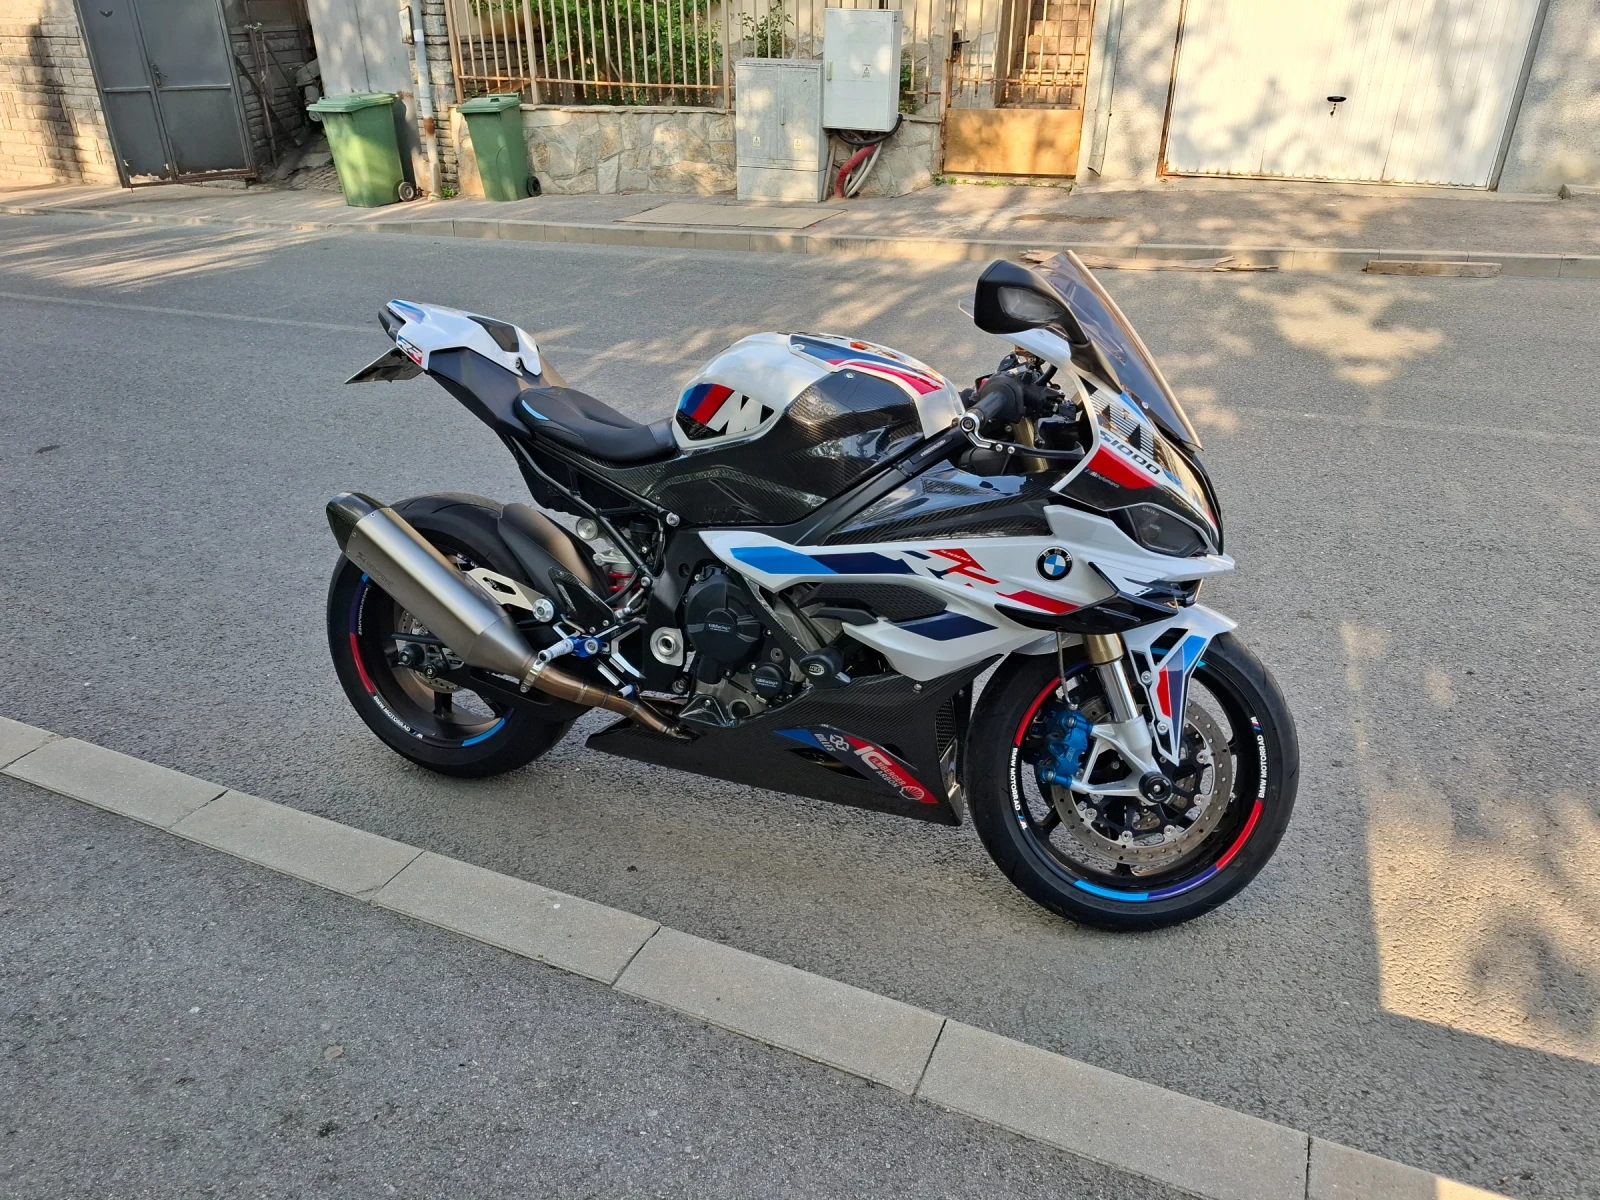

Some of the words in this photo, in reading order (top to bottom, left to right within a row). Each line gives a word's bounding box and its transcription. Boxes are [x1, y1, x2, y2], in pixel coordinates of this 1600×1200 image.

[1100, 430, 1160, 475] S1000
[373, 695, 385, 709] BMW
[383, 708, 411, 732] MOTORRAD
[870, 757, 906, 785] ILMBERGER
[1010, 747, 1018, 768] BMW
[1257, 735, 1267, 778] MOTORRAD
[1010, 768, 1020, 811] MOTORRAD
[1258, 778, 1267, 798] BMW
